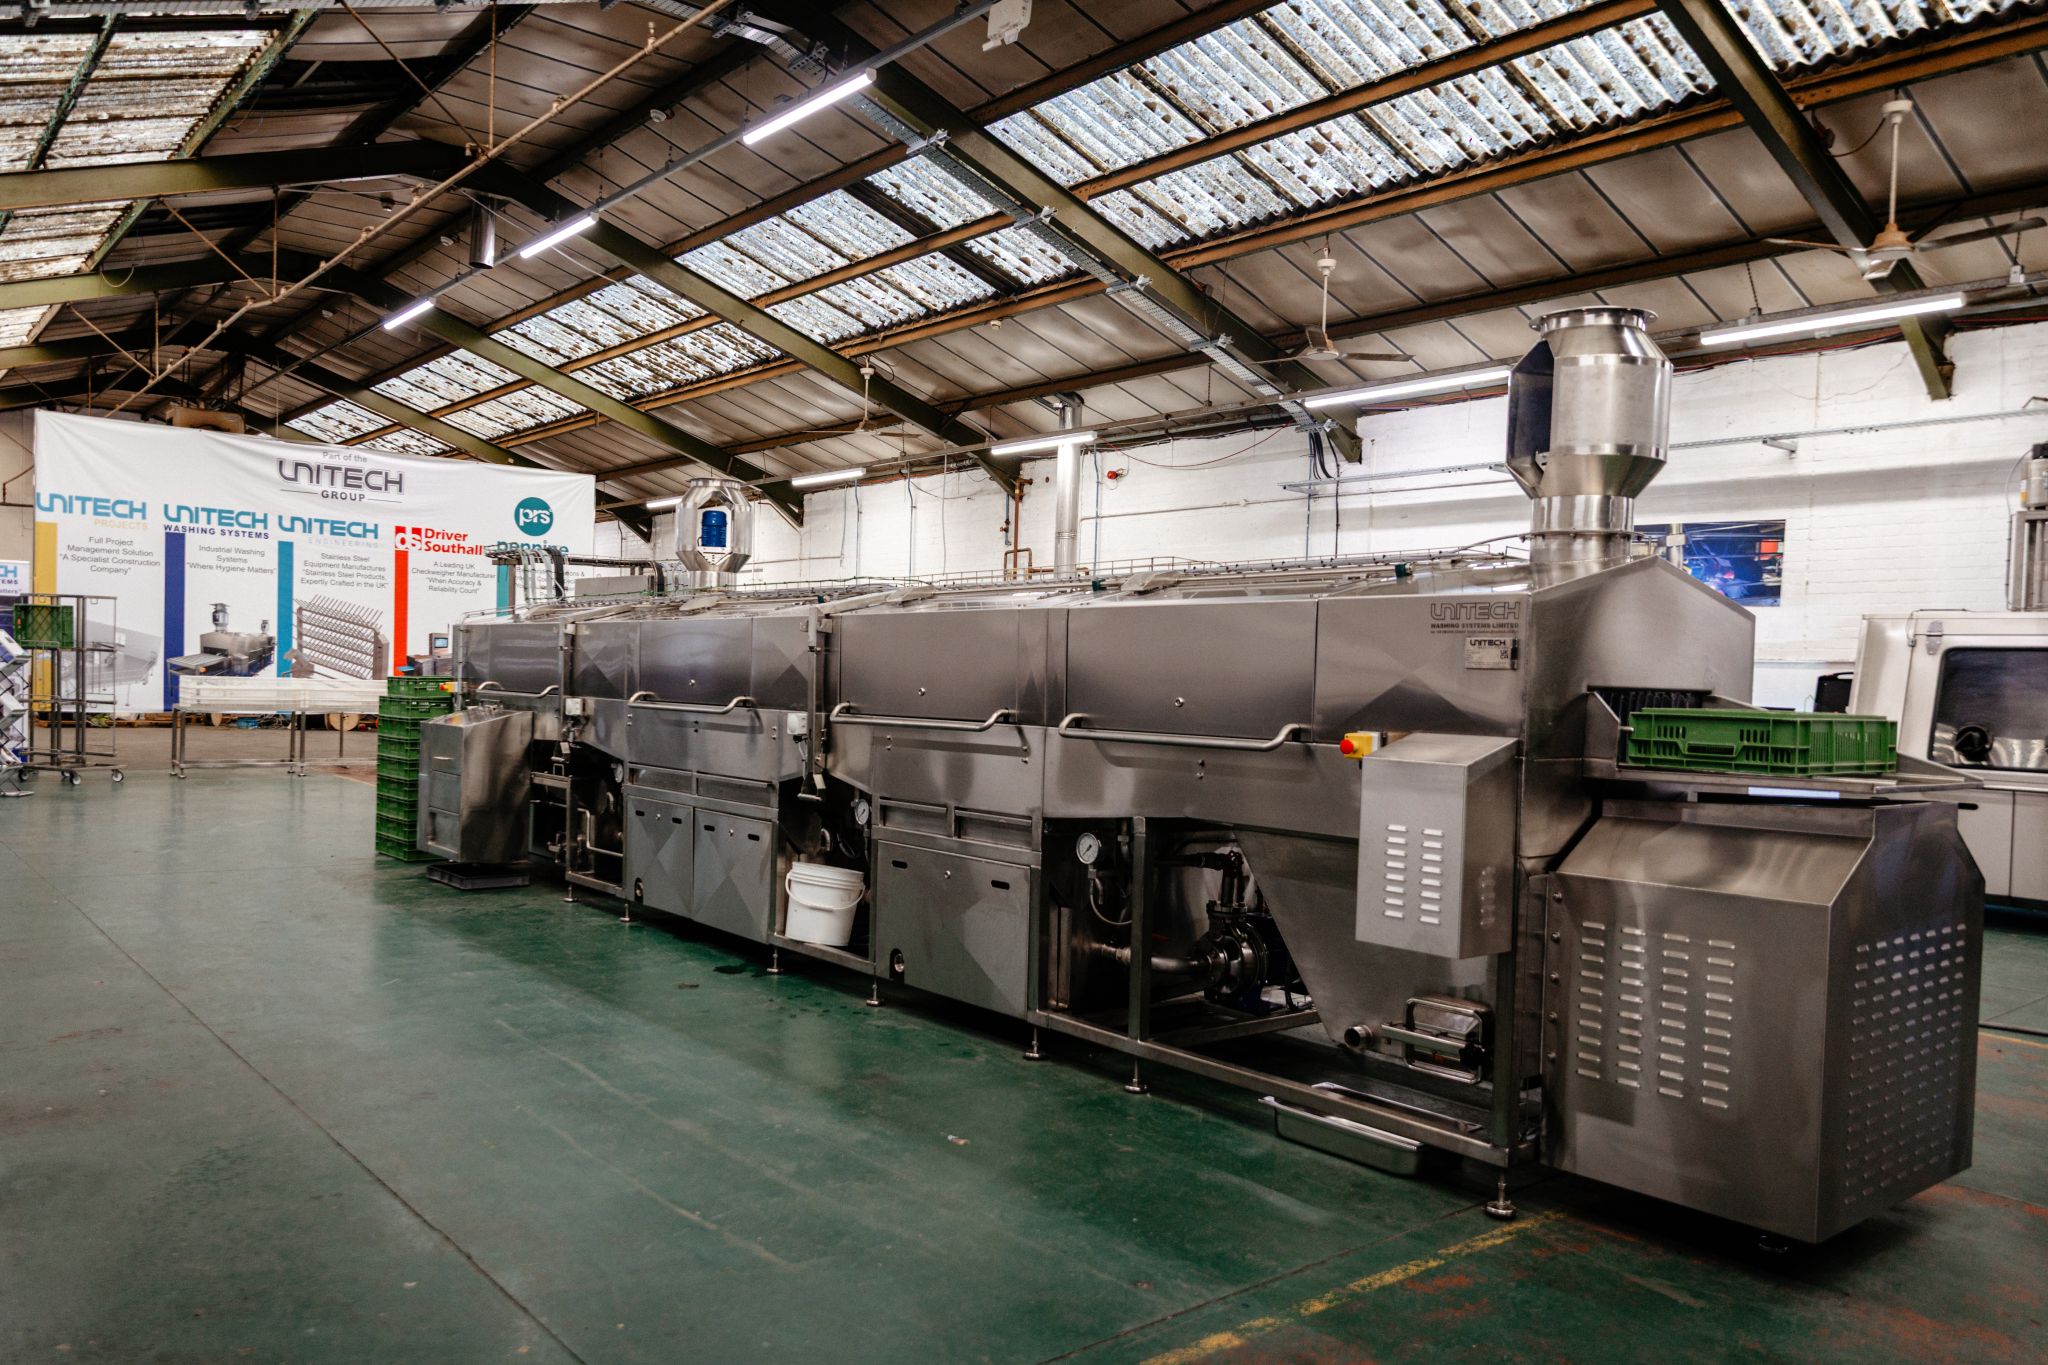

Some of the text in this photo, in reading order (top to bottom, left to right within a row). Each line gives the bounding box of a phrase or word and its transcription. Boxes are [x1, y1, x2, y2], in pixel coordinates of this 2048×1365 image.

[322, 451, 368, 463] Part of the
[278, 459, 403, 493] UNITECH
[321, 490, 366, 501] GROUP
[36, 492, 147, 520] UNITECH
[163, 504, 268, 530] UNITECH
[518, 508, 551, 526] prs
[94, 518, 148, 530] PROJECTS
[278, 515, 379, 540] UNITECH
[163, 524, 270, 540] WASHING SYSTEMS
[424, 528, 468, 541] Driver
[89, 536, 134, 546] Full Project
[308, 536, 379, 548] ENGINEERING
[67, 544, 154, 557] Management Solution
[198, 545, 266, 557] Industrial Washing
[424, 540, 483, 556] Southall
[71, 554, 110, 564] Specialist
[111, 557, 161, 567] Construction
[216, 555, 248, 564] Systems
[320, 552, 351, 561] Stainless
[215, 564, 246, 573] Hygiene
[303, 560, 386, 572] Equipment Manufactures
[440, 561, 464, 570] Leading
[411, 567, 496, 579] Checkweigher Manufacturer
[300, 577, 328, 586] Expertly
[330, 579, 354, 587] Crafted
[447, 578, 476, 587] Accuracy
[428, 585, 458, 594] Reliability
[1431, 601, 1520, 621] UNITECH
[1469, 639, 1506, 647] UNITECH
